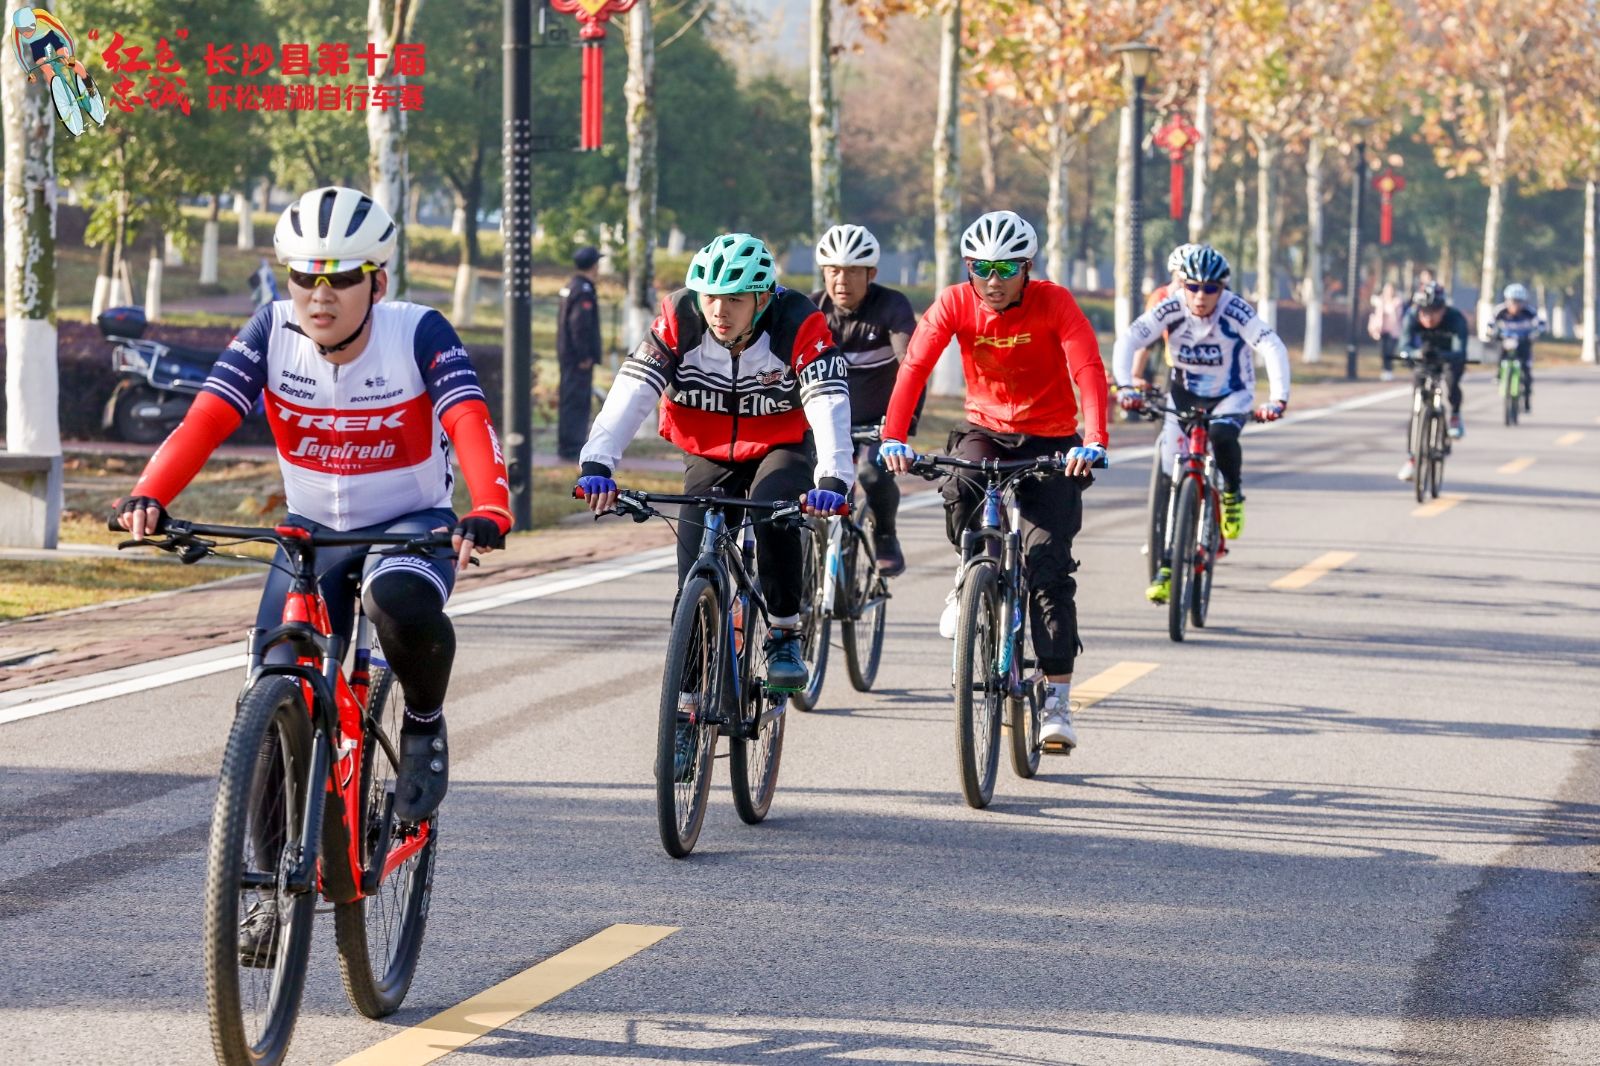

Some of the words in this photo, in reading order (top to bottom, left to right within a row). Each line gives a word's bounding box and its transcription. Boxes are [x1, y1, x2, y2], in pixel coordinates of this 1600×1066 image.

[281, 370, 317, 386] SRAM
[279, 382, 316, 400] Santini
[350, 388, 404, 402] BONTRAGER
[275, 402, 407, 432] TREK
[289, 436, 396, 461] Segafredo
